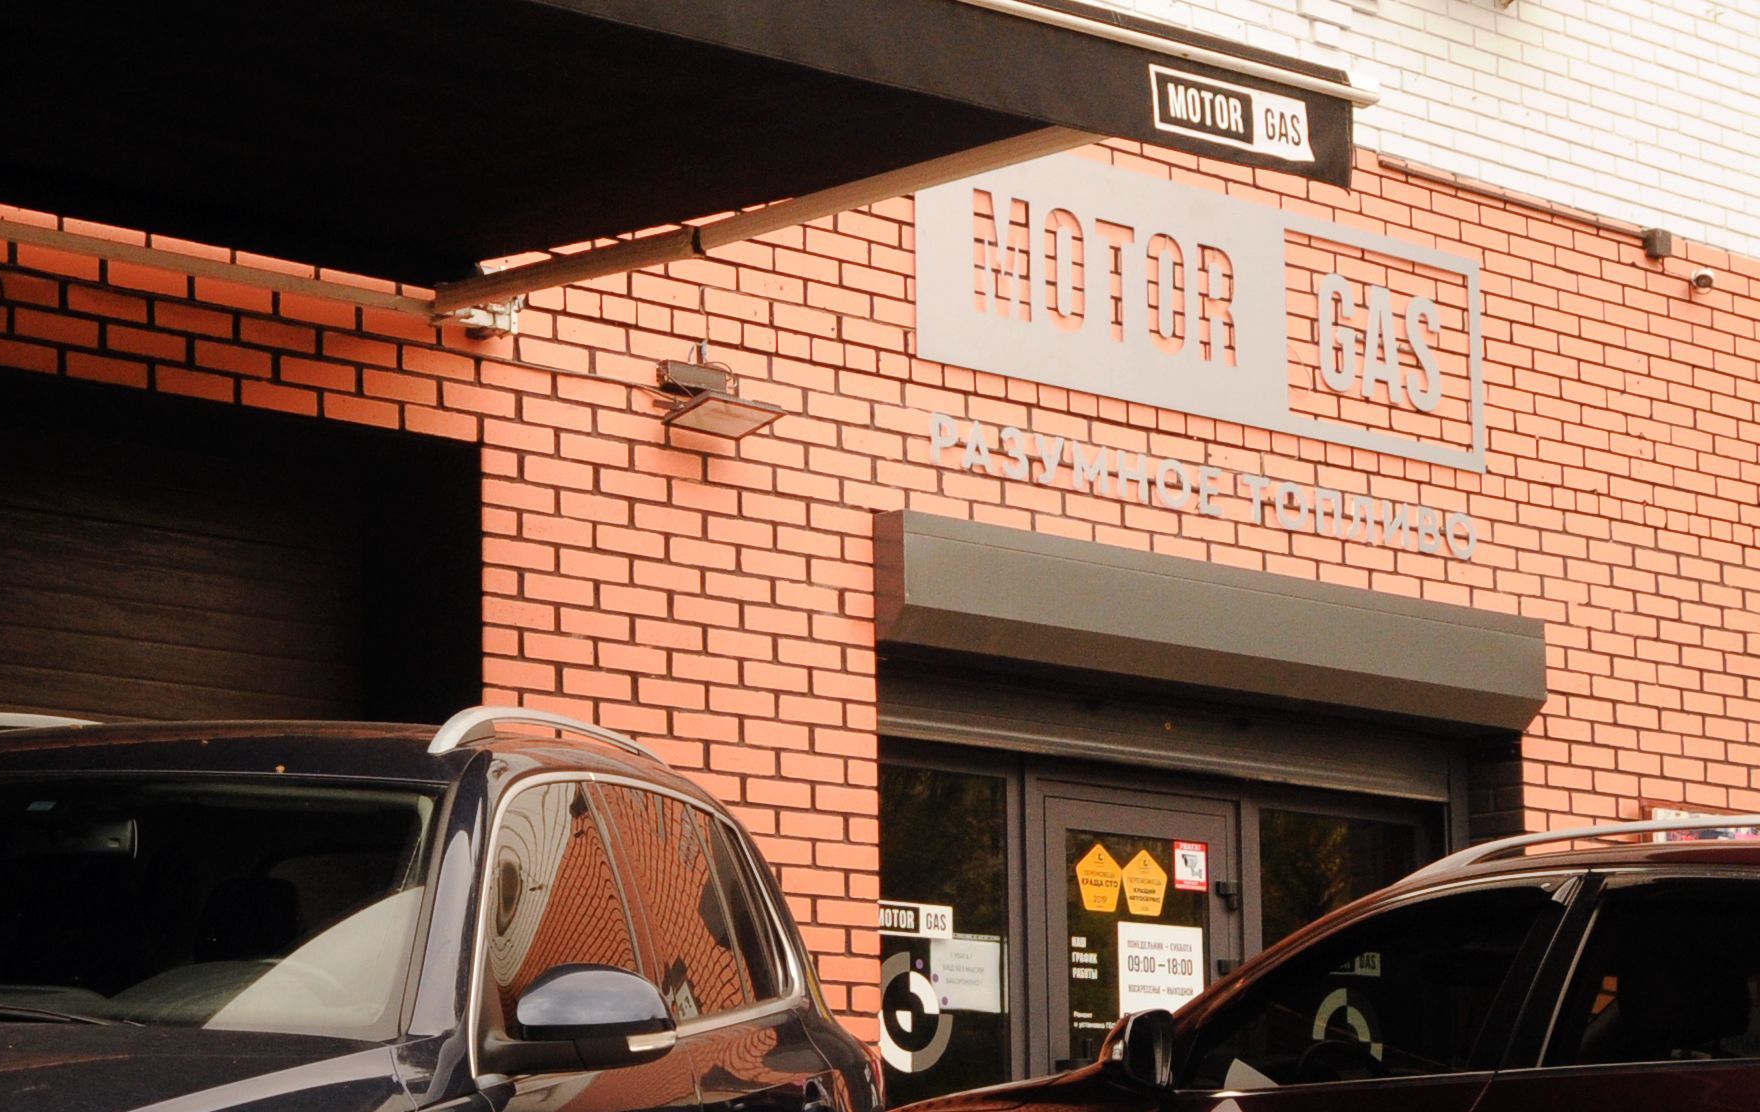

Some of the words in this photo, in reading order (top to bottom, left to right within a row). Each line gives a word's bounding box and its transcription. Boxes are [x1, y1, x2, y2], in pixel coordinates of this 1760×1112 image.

[1167, 82, 1244, 134] MOTOR
[1264, 108, 1302, 146] GAS
[972, 187, 1238, 367] MOTOR
[1318, 272, 1442, 413] GAS
[929, 413, 1223, 517] РАЗУМНОЕ
[1241, 474, 1479, 560] ТОПЛИВО
[926, 912, 947, 931] GAS
[1127, 955, 1156, 973] 09:00
[1167, 958, 1193, 976] 18:00
